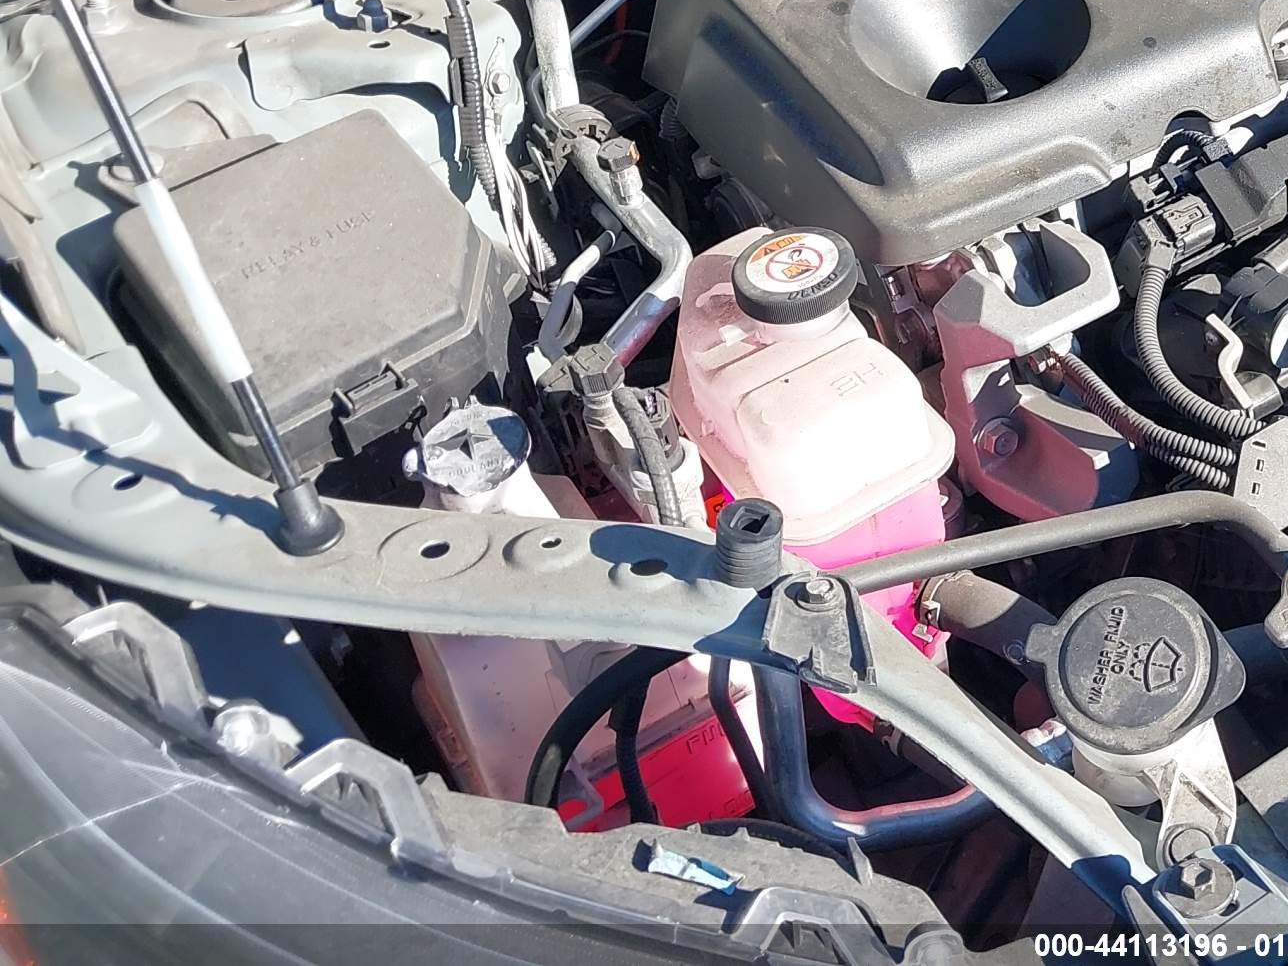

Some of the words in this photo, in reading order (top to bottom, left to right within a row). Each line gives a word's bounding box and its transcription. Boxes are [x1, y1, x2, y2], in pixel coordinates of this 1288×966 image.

[786, 272, 840, 302] DENSO
[1087, 649, 1113, 705] WASHER
[1103, 606, 1125, 644] FLUID
[1109, 639, 1131, 675] ONLY
